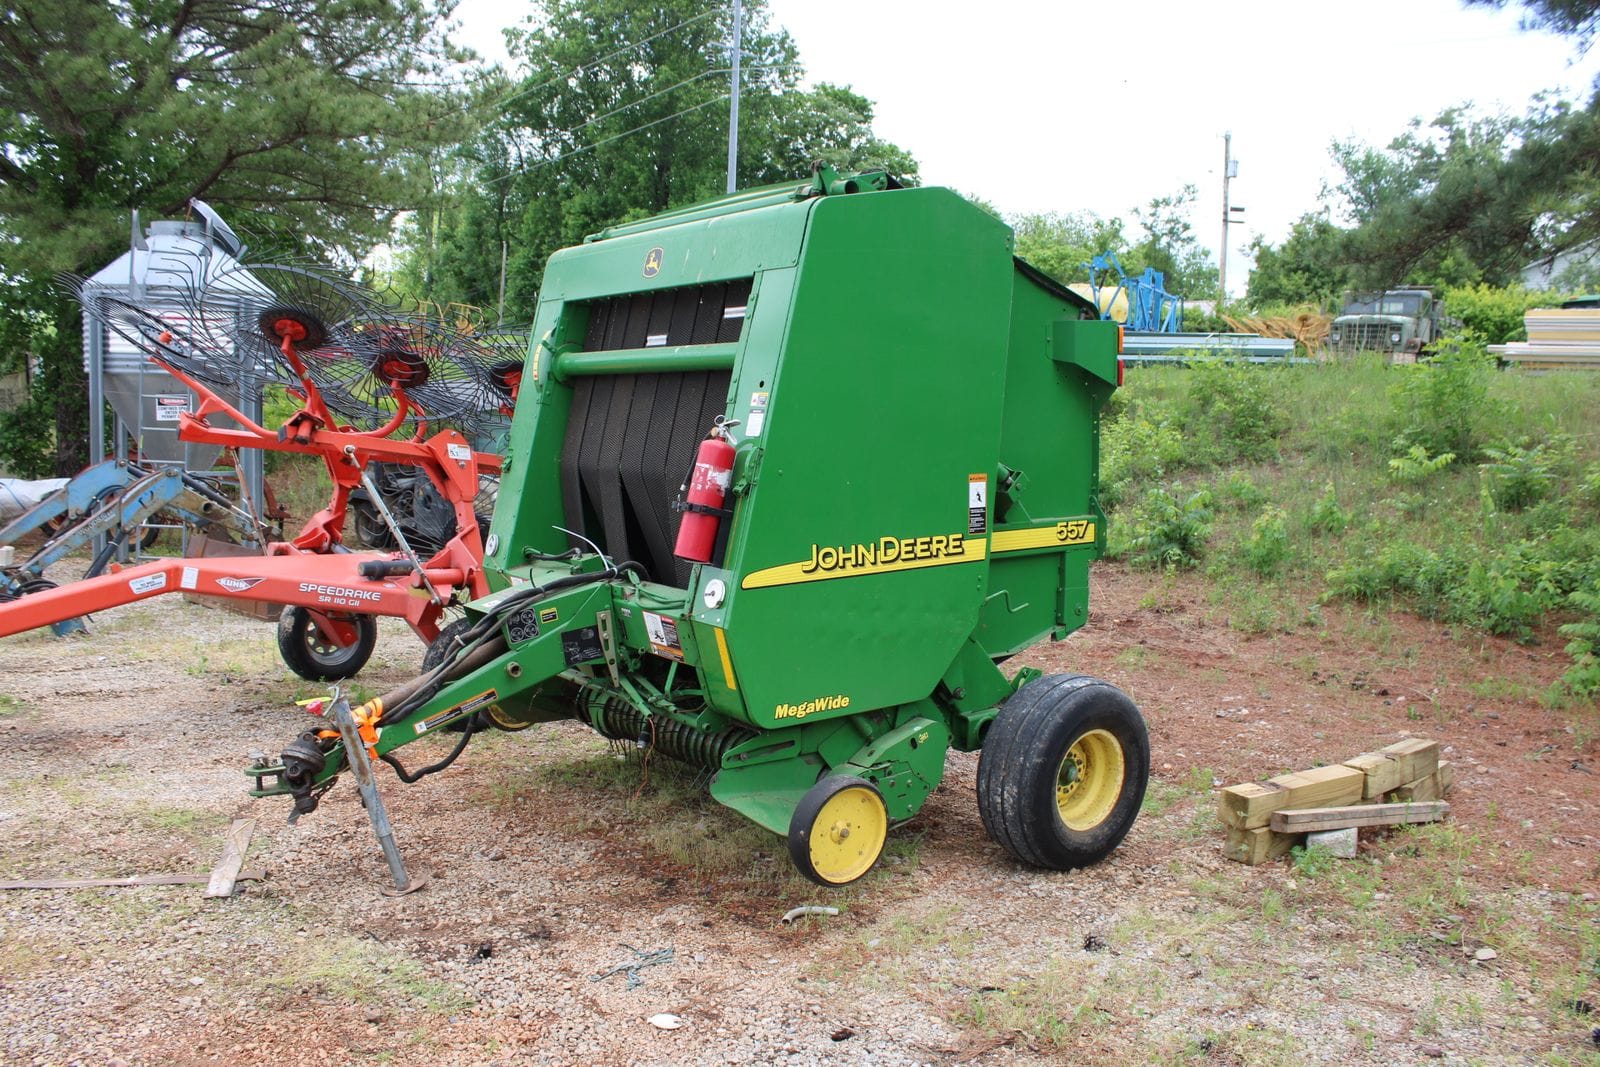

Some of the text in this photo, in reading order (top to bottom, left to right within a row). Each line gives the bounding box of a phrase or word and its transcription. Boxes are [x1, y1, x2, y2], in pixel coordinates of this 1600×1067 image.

[1057, 520, 1088, 541] 557
[802, 533, 964, 573] JOHN DEERE
[220, 578, 247, 589] KUHN
[298, 583, 382, 601] SPEEDRAKE
[318, 595, 331, 603] SR
[774, 695, 851, 720] MegaWide
